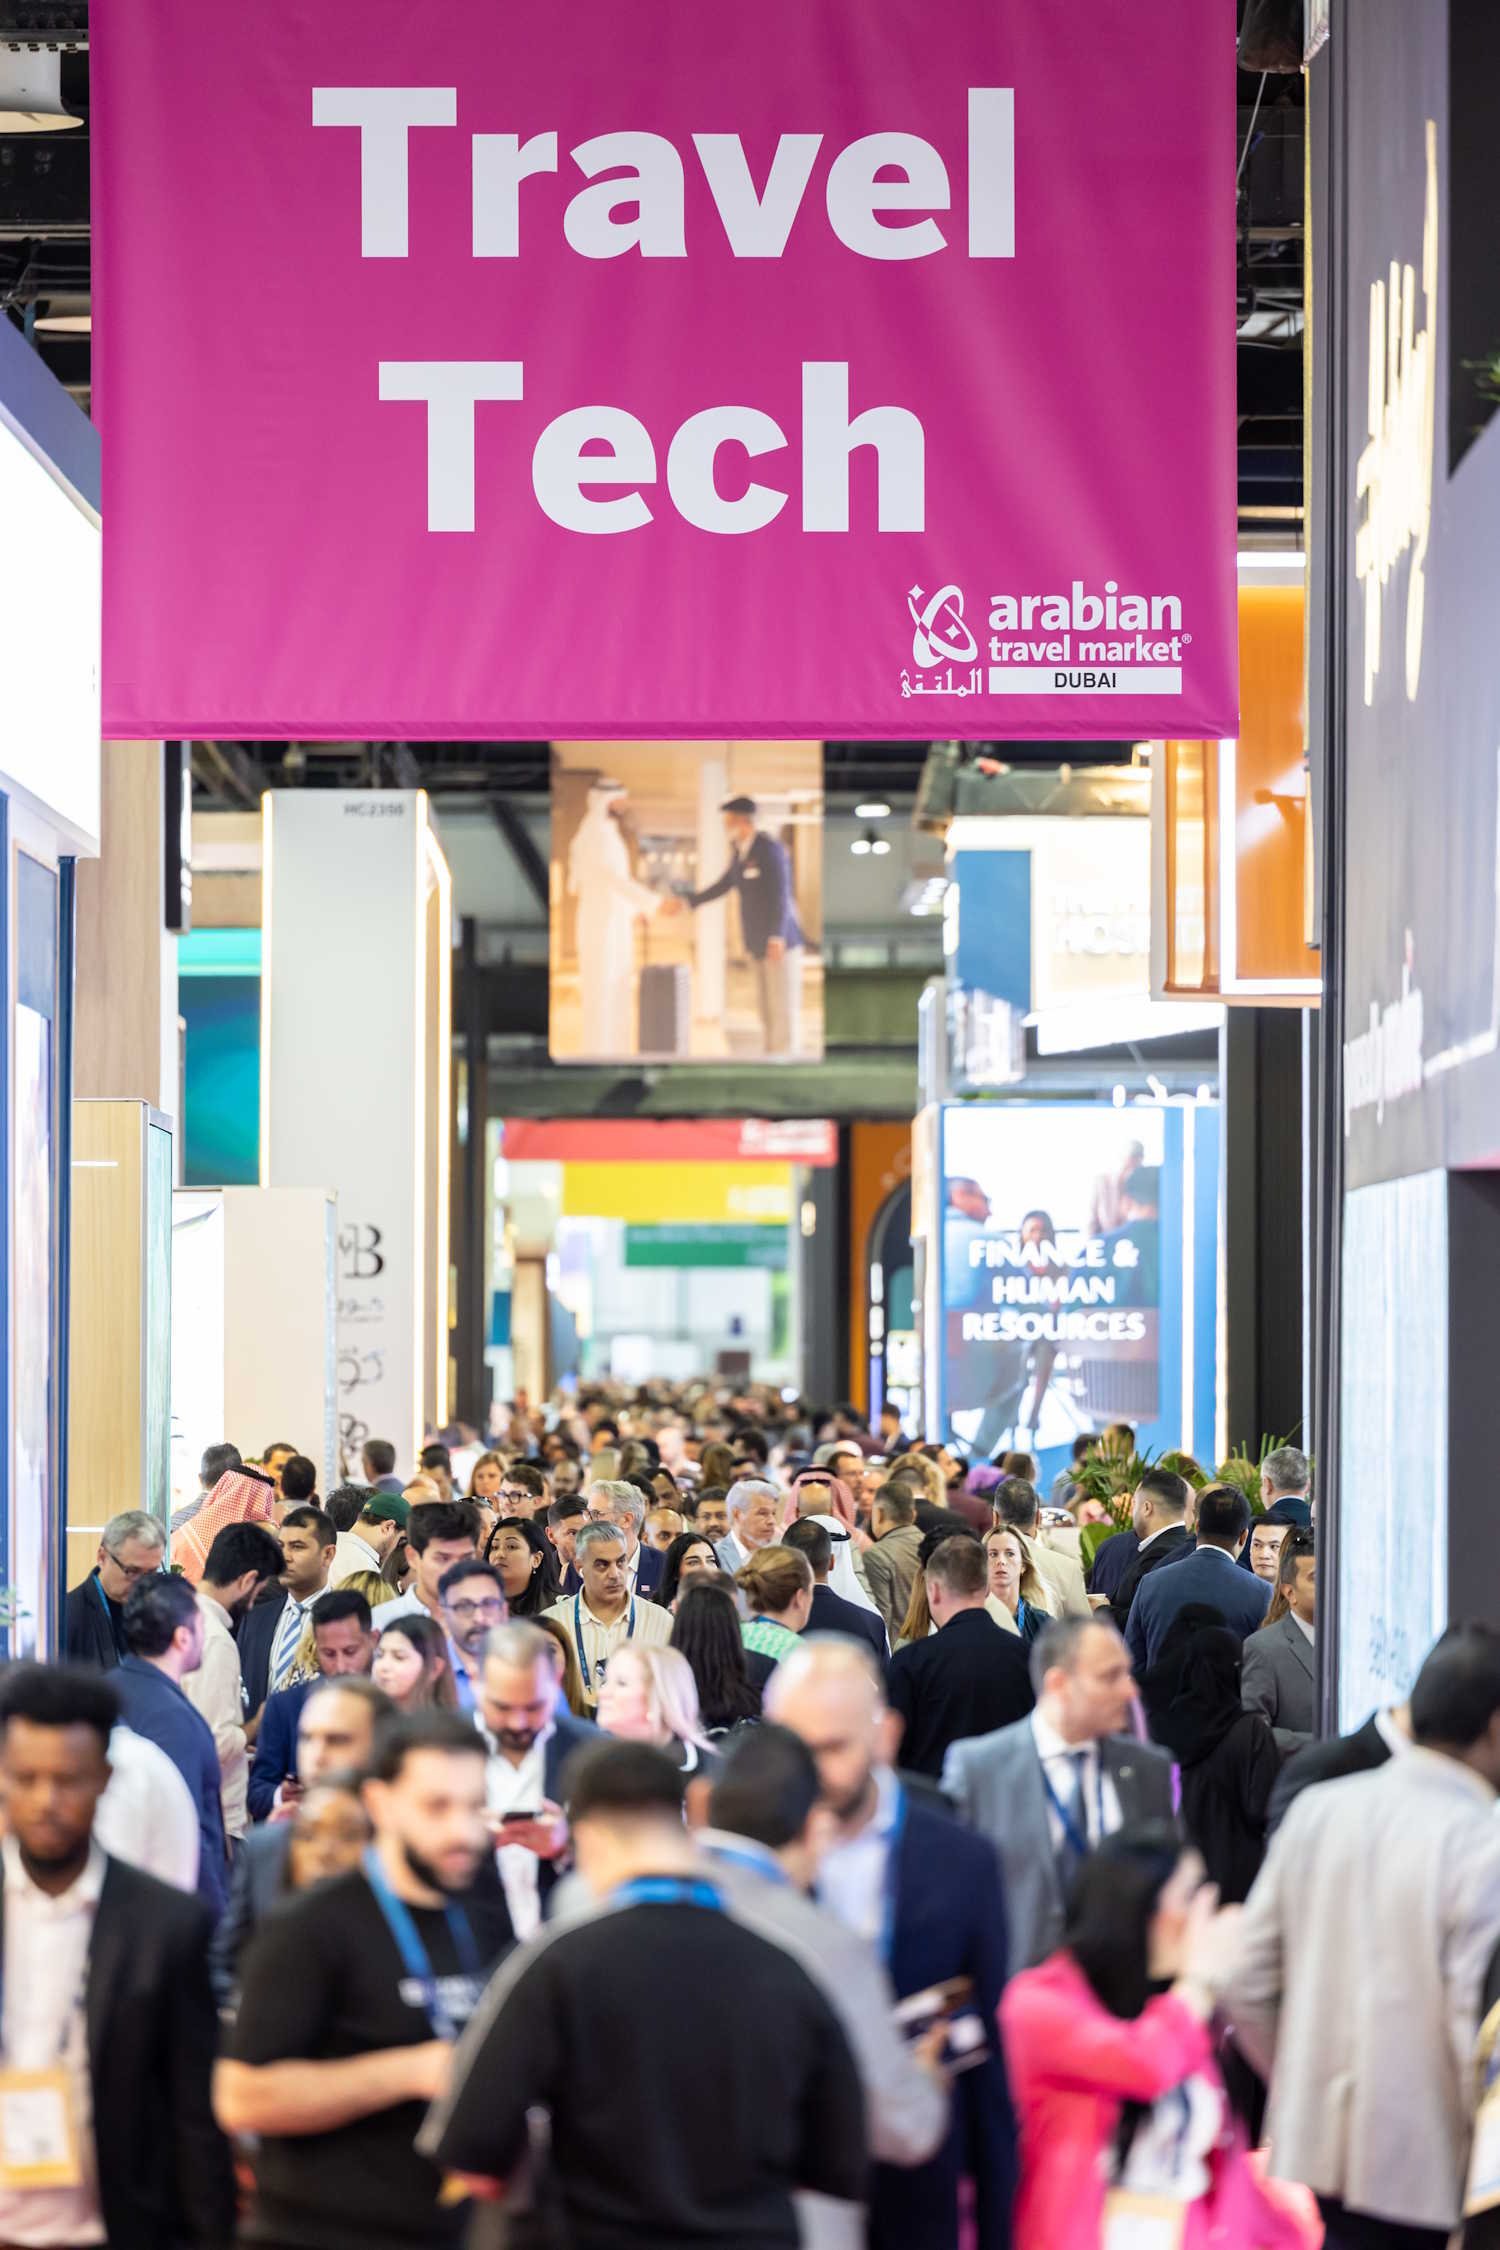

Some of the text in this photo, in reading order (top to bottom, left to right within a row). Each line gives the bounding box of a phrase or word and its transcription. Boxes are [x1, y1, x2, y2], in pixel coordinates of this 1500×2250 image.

[312, 87, 1016, 261] Travel
[378, 360, 926, 535] Tech
[988, 580, 1182, 631] arabian
[988, 634, 1071, 662] travel
[1054, 672, 1117, 689] DUBAI
[968, 1238, 1140, 1268] FINANCE &
[992, 1276, 1116, 1304] HUMAN
[962, 1312, 1147, 1341] RESOURCES
